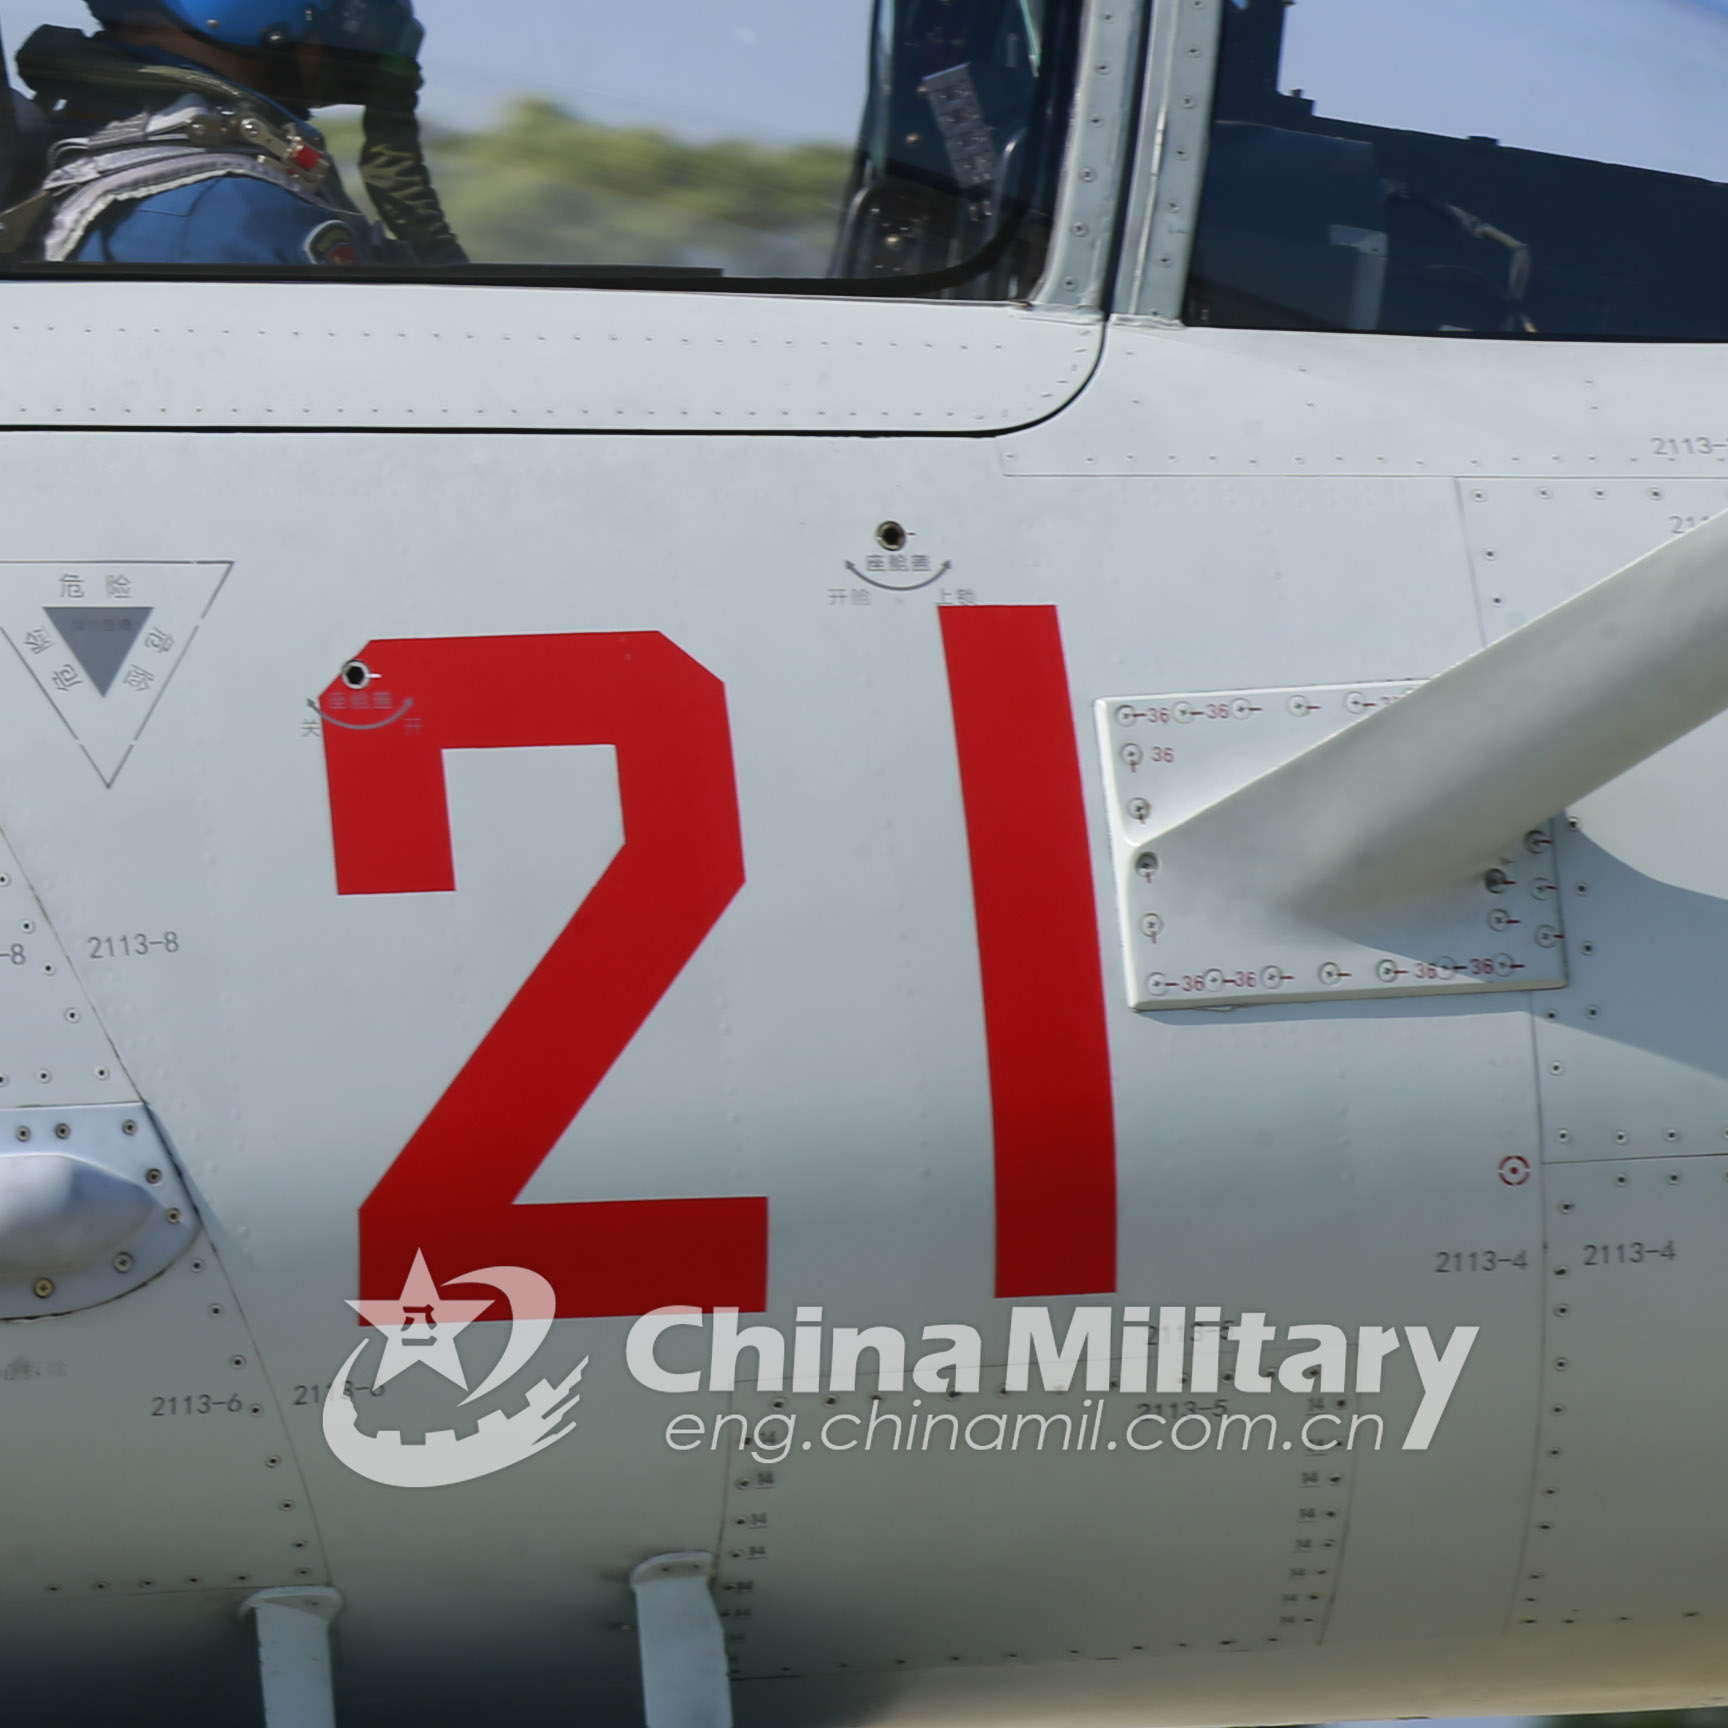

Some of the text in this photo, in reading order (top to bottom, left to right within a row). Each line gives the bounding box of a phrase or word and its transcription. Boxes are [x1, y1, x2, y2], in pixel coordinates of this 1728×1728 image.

[1649, 436, 1728, 455] 2113-
[58, 573, 132, 599] 危险
[24, 626, 85, 692] 危险
[1147, 707, 1170, 723] 36
[1206, 703, 1230, 719] 36
[1151, 746, 1174, 762] 36
[87, 931, 180, 959] 2113-8
[318, 605, 1117, 1326] 21
[1182, 975, 1204, 991] 36
[1234, 971, 1257, 988] 36
[1435, 1250, 1528, 1273] 2113-4
[1583, 1240, 1676, 1266] 2113-4
[150, 1392, 243, 1417] 2113-6
